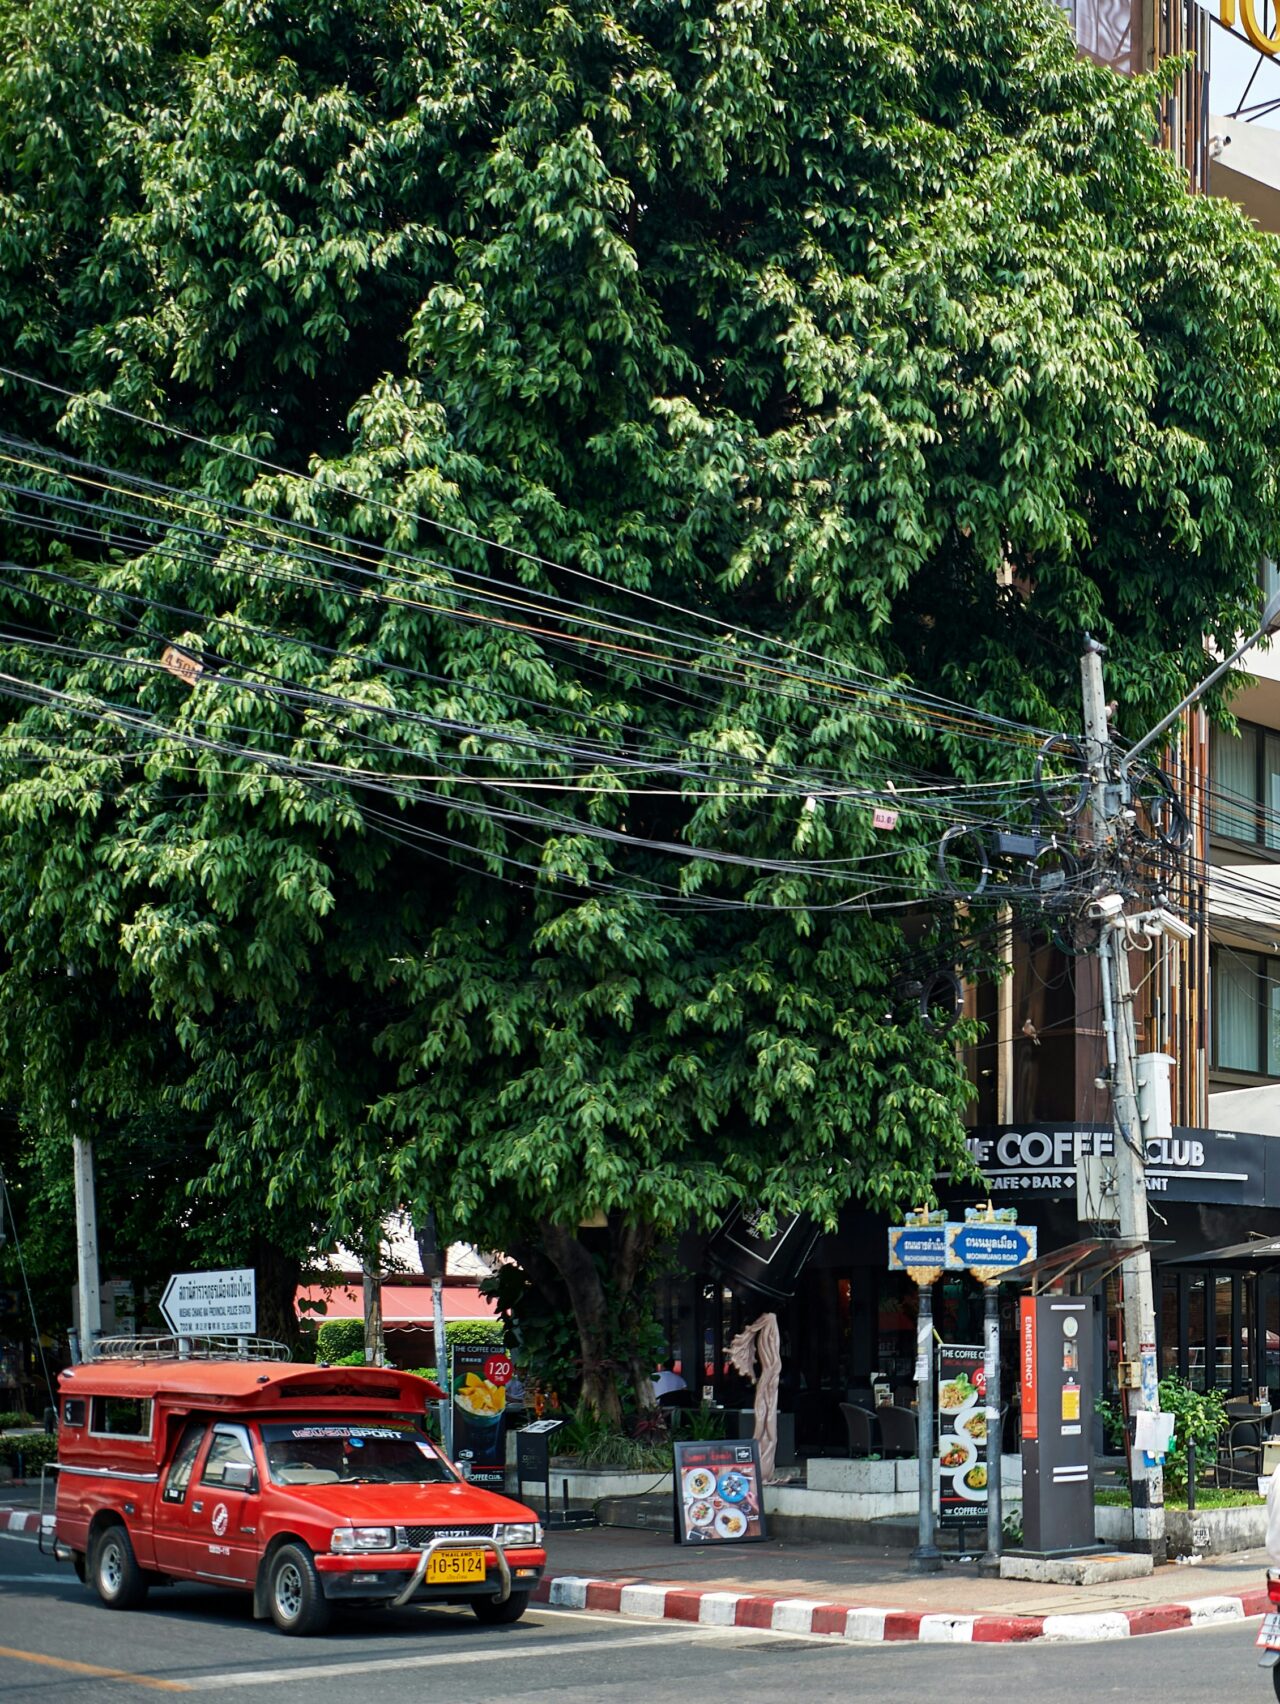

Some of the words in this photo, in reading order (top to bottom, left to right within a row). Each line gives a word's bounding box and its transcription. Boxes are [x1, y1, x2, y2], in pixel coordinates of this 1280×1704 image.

[1147, 1140, 1205, 1167] CLUB
[1032, 1175, 1062, 1189] BAR
[1002, 1254, 1019, 1262] ROAD
[455, 1345, 465, 1353] THE
[942, 1349, 954, 1358] THE
[954, 1350, 978, 1359] COFFEE
[1025, 1316, 1033, 1388] EMERGENCY
[488, 1362, 510, 1375] 120
[292, 1429, 350, 1438] ISUZU
[350, 1430, 402, 1439] SPORT
[953, 1507, 977, 1516] COFFEE
[433, 1557, 482, 1574] 10-5124
